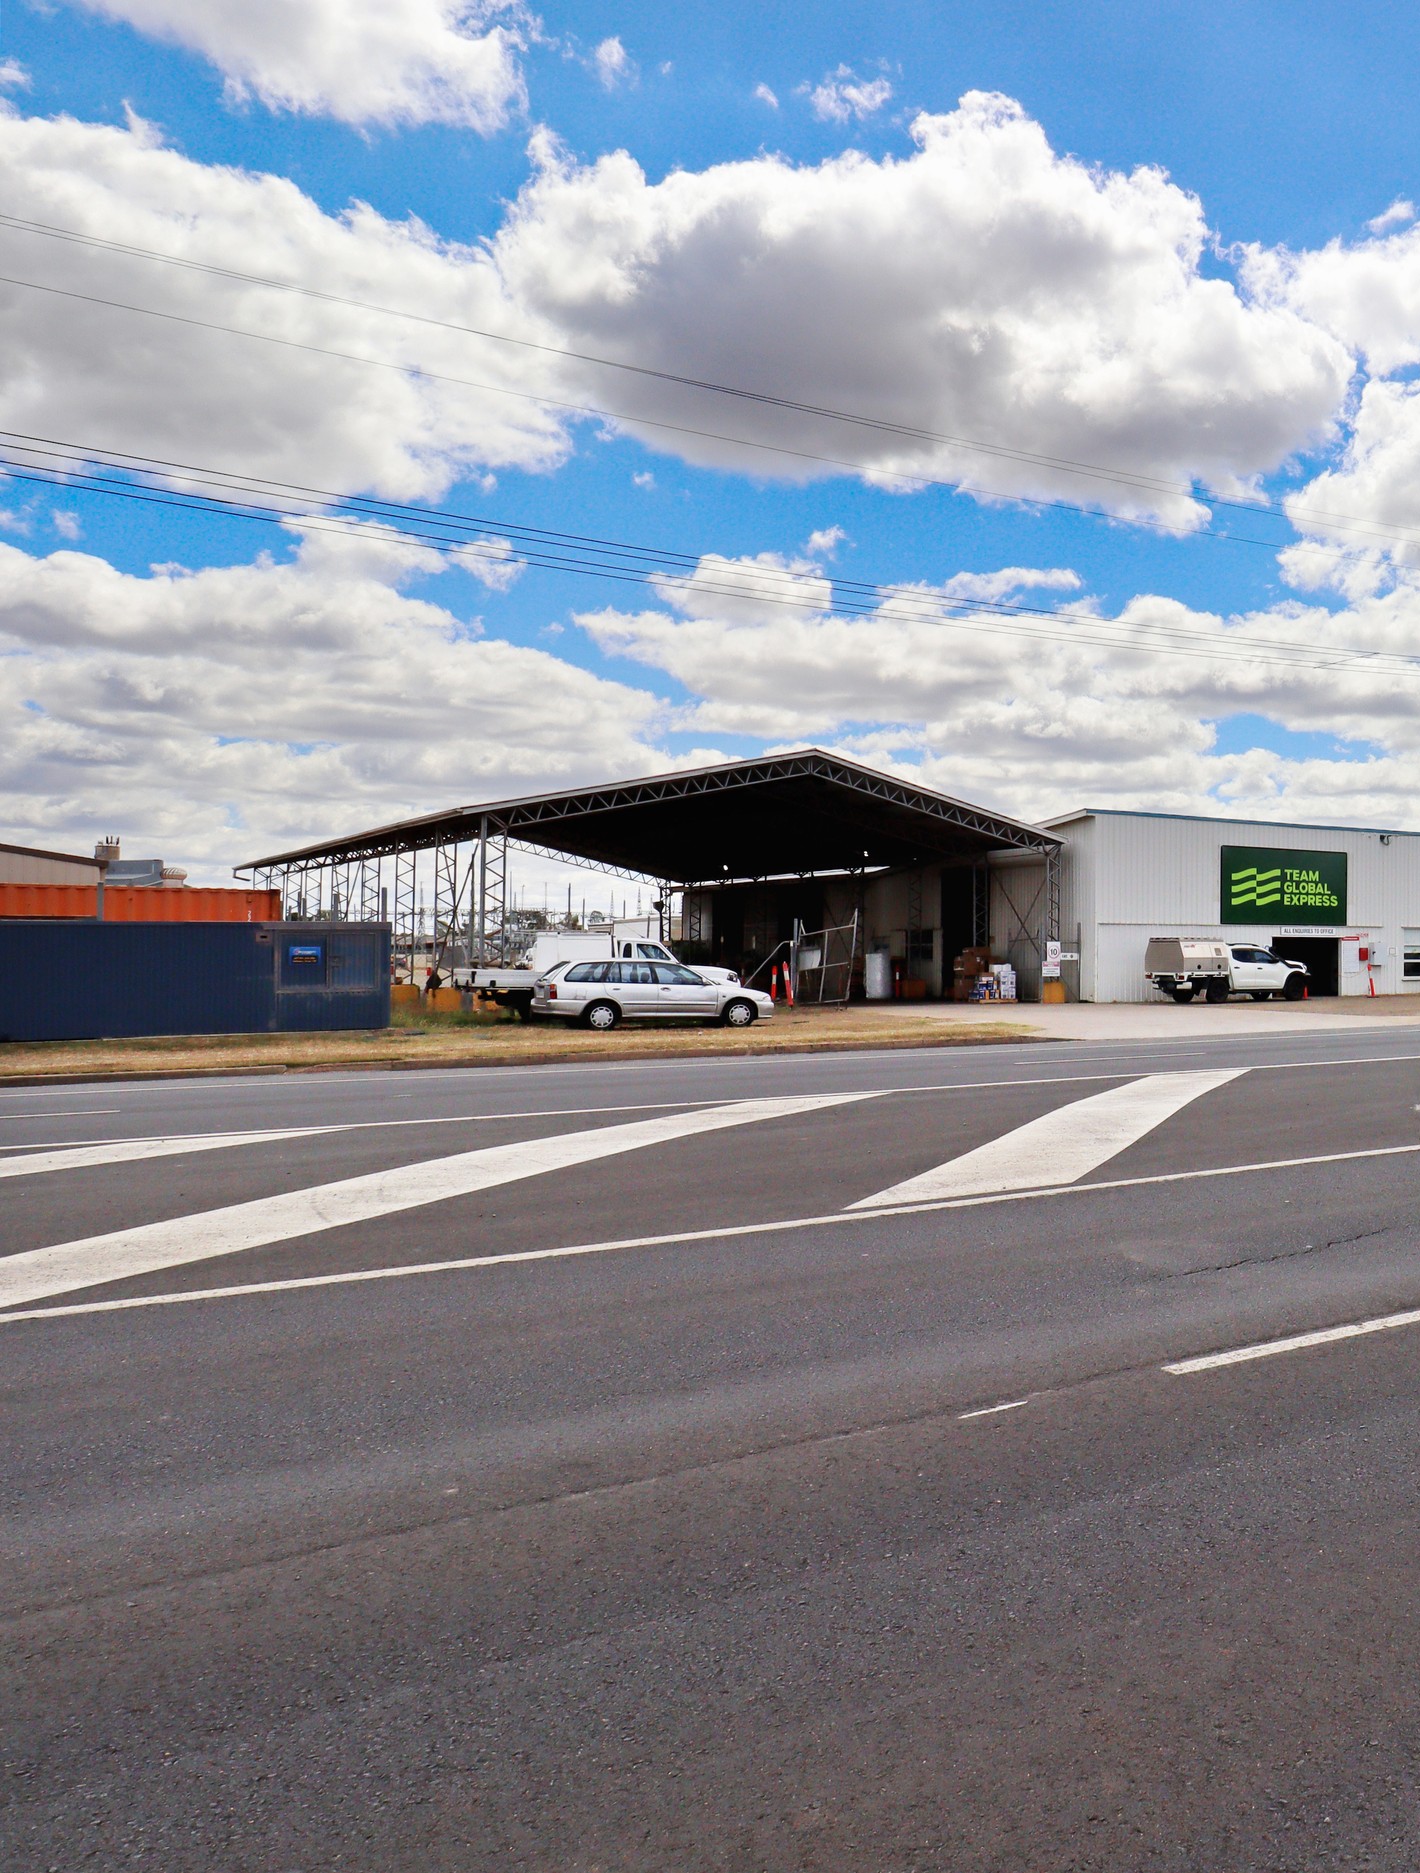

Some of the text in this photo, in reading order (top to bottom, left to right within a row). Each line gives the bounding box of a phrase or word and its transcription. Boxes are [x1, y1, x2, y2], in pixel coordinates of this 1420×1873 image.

[1284, 869, 1319, 881] TEAM
[1284, 882, 1331, 894] GLOBAL
[1284, 895, 1338, 907] EXPRESS
[1050, 948, 1058, 956] 10
